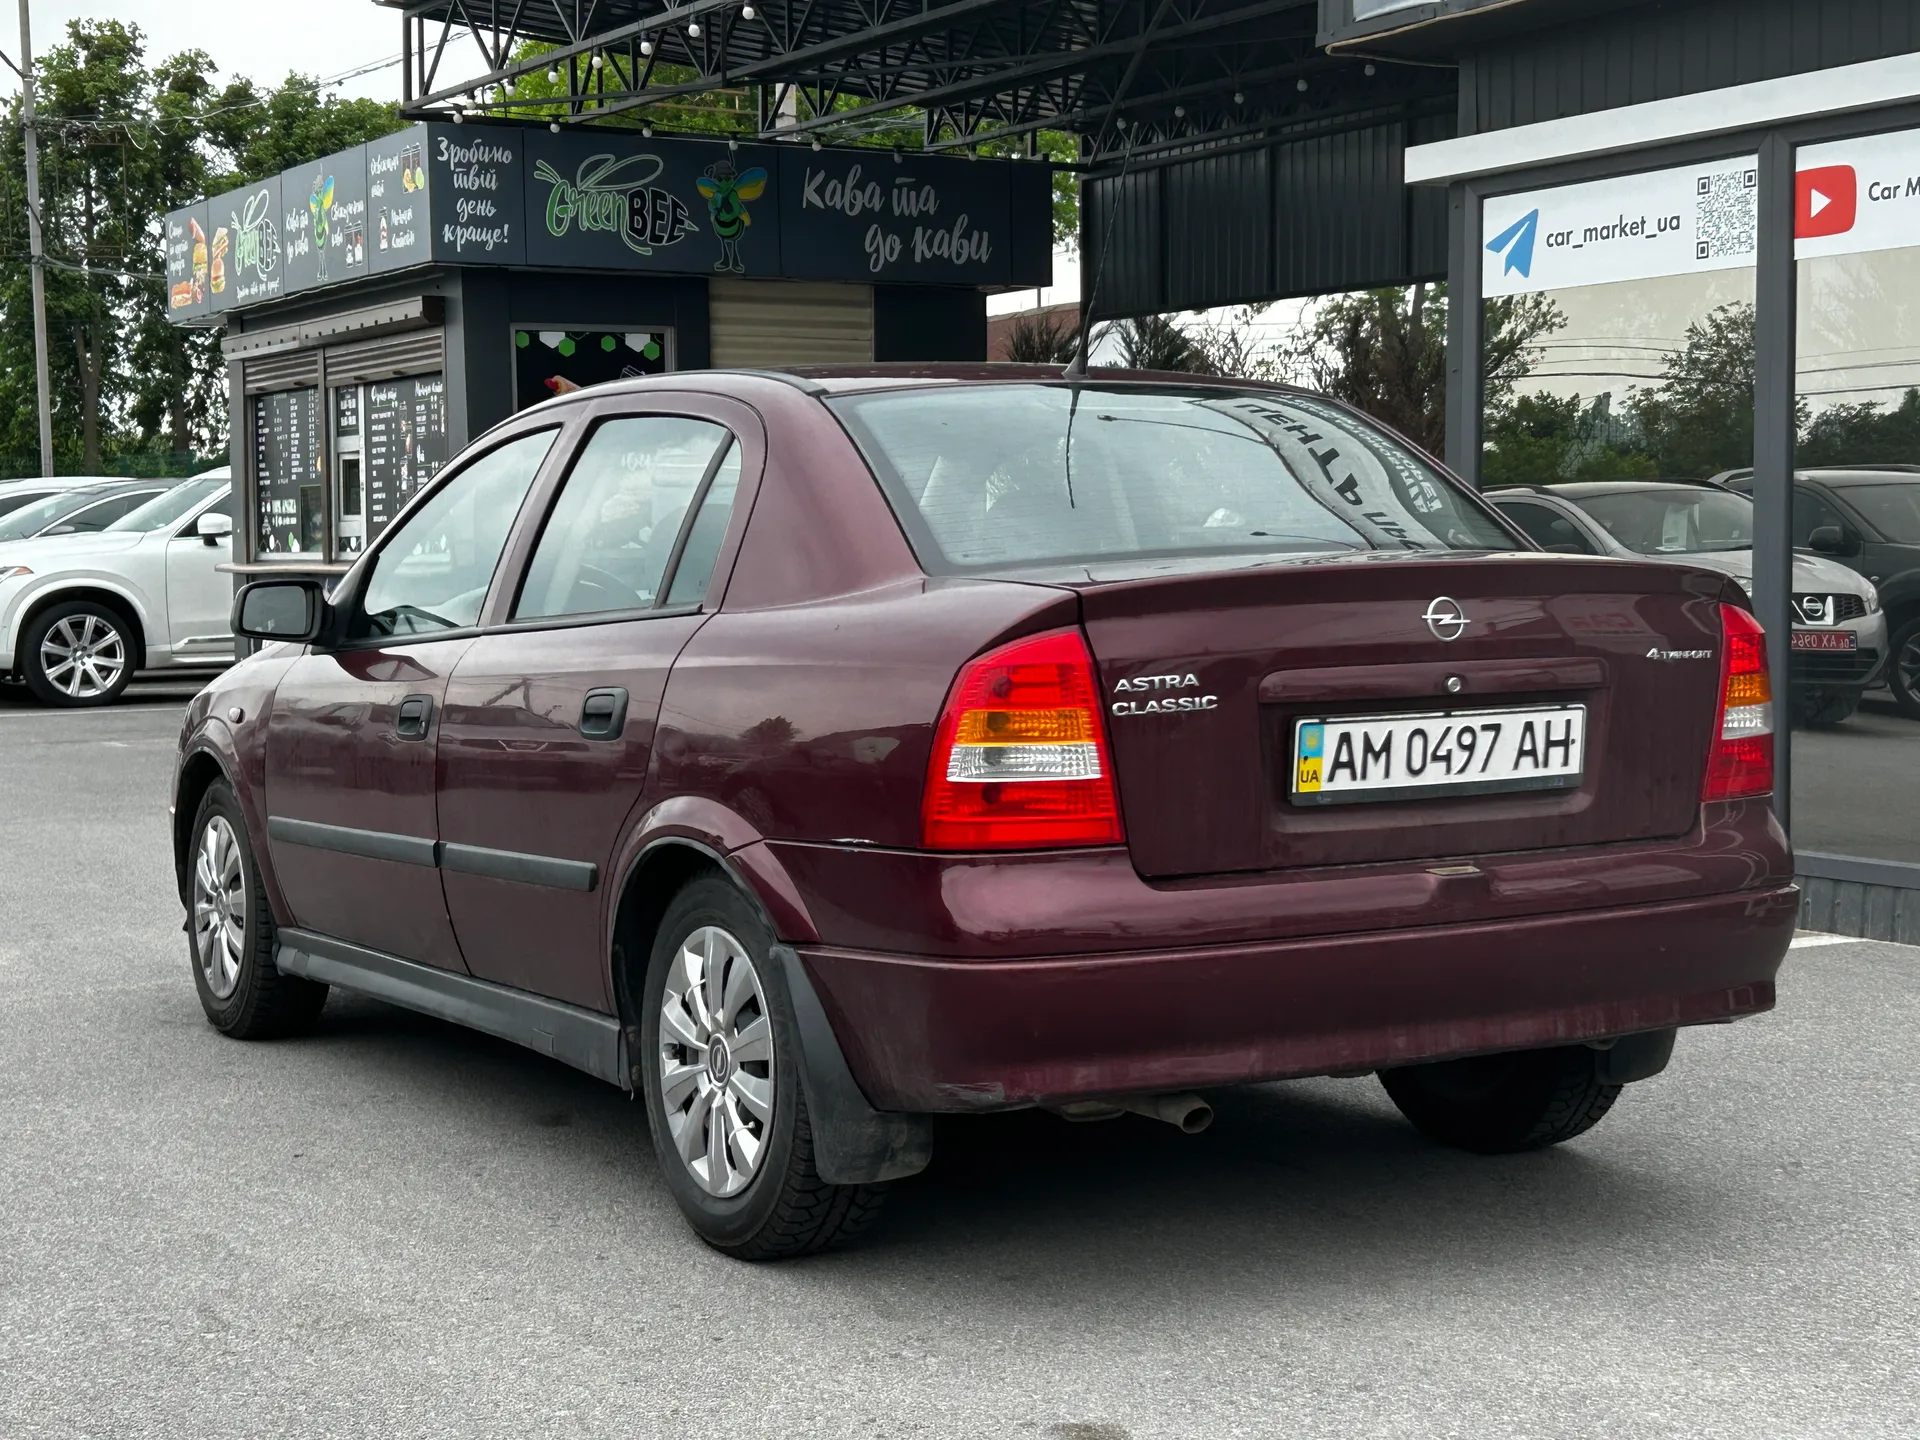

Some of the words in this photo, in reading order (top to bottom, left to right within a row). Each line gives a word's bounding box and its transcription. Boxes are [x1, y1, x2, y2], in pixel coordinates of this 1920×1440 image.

[437, 137, 512, 170] Зробимо
[453, 164, 498, 190] твій
[802, 164, 885, 216] Кава
[892, 177, 939, 217] та
[1868, 181, 1901, 201] Car
[456, 198, 497, 222] день
[442, 224, 509, 252] краще!
[864, 224, 902, 272] до
[911, 214, 992, 264] кави
[1546, 214, 1681, 249] car_market_ua
[1113, 673, 1199, 693] ASTRA
[1112, 695, 1218, 716] CLASSIC
[1327, 730, 1393, 783] AM
[1405, 723, 1502, 778] 0497
[1512, 719, 1571, 771] AH
[1300, 770, 1319, 783] UA
